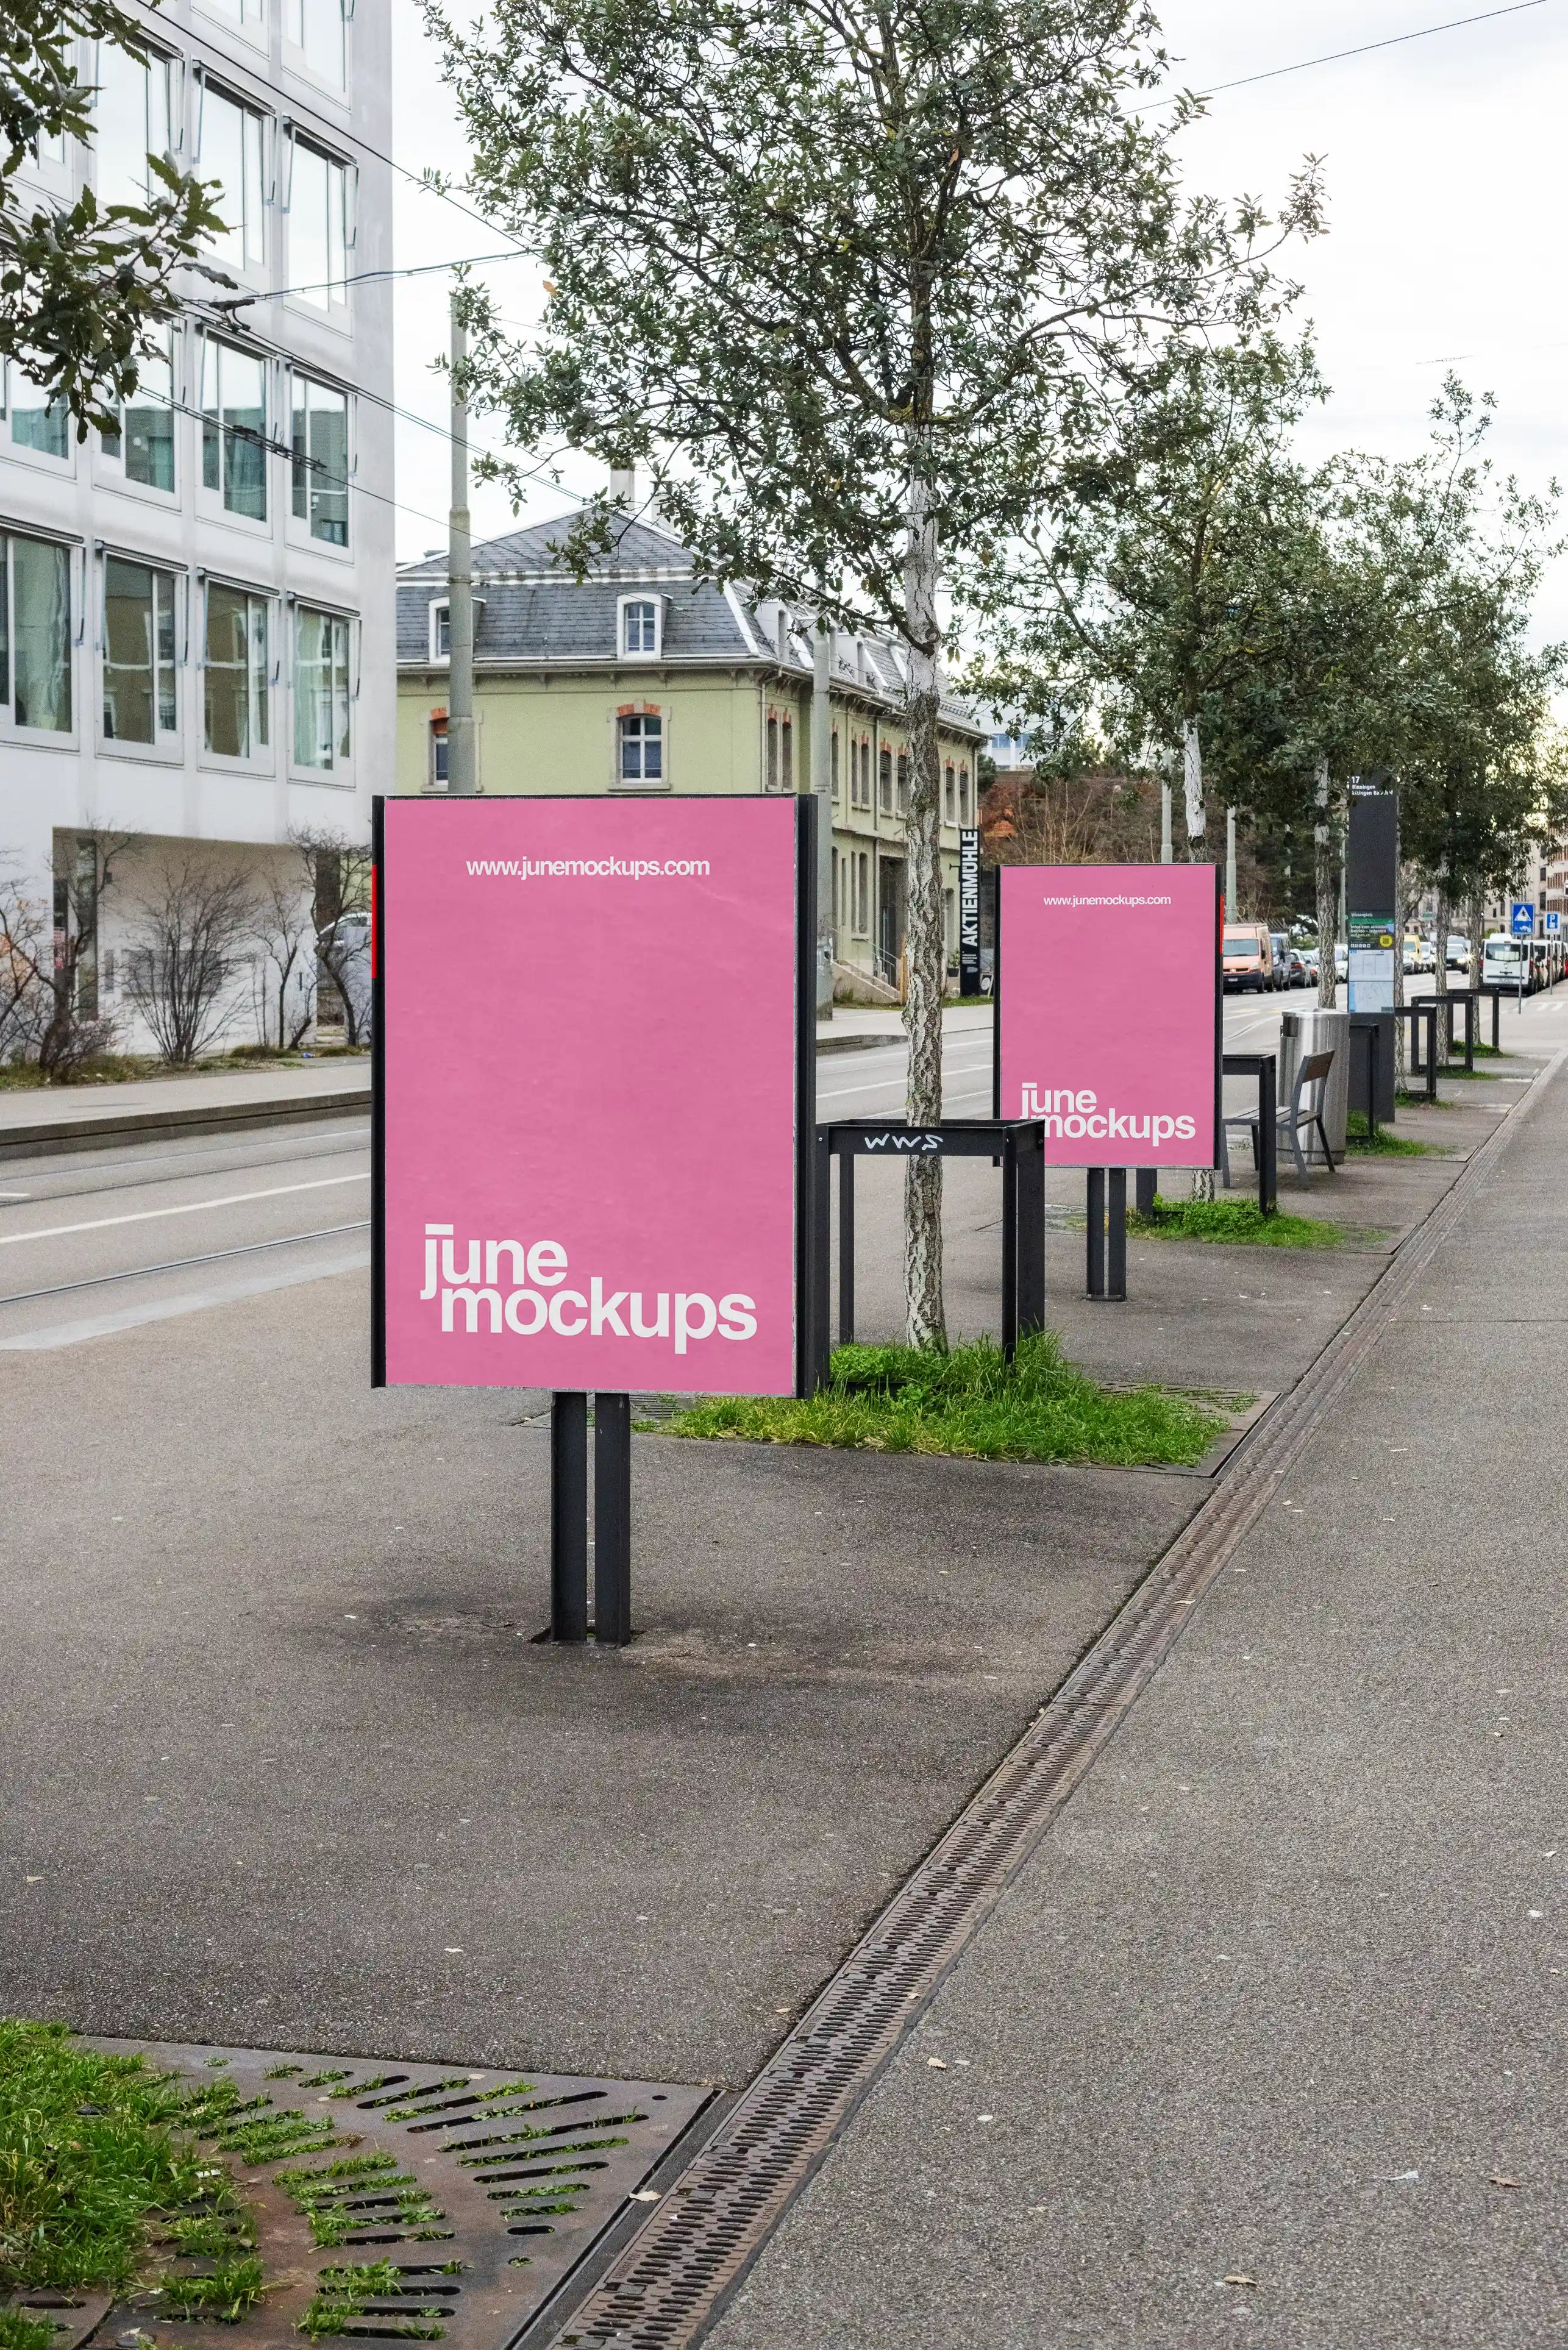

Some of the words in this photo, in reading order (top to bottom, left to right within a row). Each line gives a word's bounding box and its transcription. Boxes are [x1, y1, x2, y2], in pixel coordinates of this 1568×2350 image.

[466, 856, 710, 881] www.junemockups.com
[962, 831, 978, 946] AKTIENMÜHLE
[1043, 894, 1171, 908] www.junemockups.com
[1019, 1082, 1097, 1120] june
[1030, 1108, 1196, 1147] mockups
[420, 1223, 568, 1300] june
[441, 1276, 757, 1355] mockups
